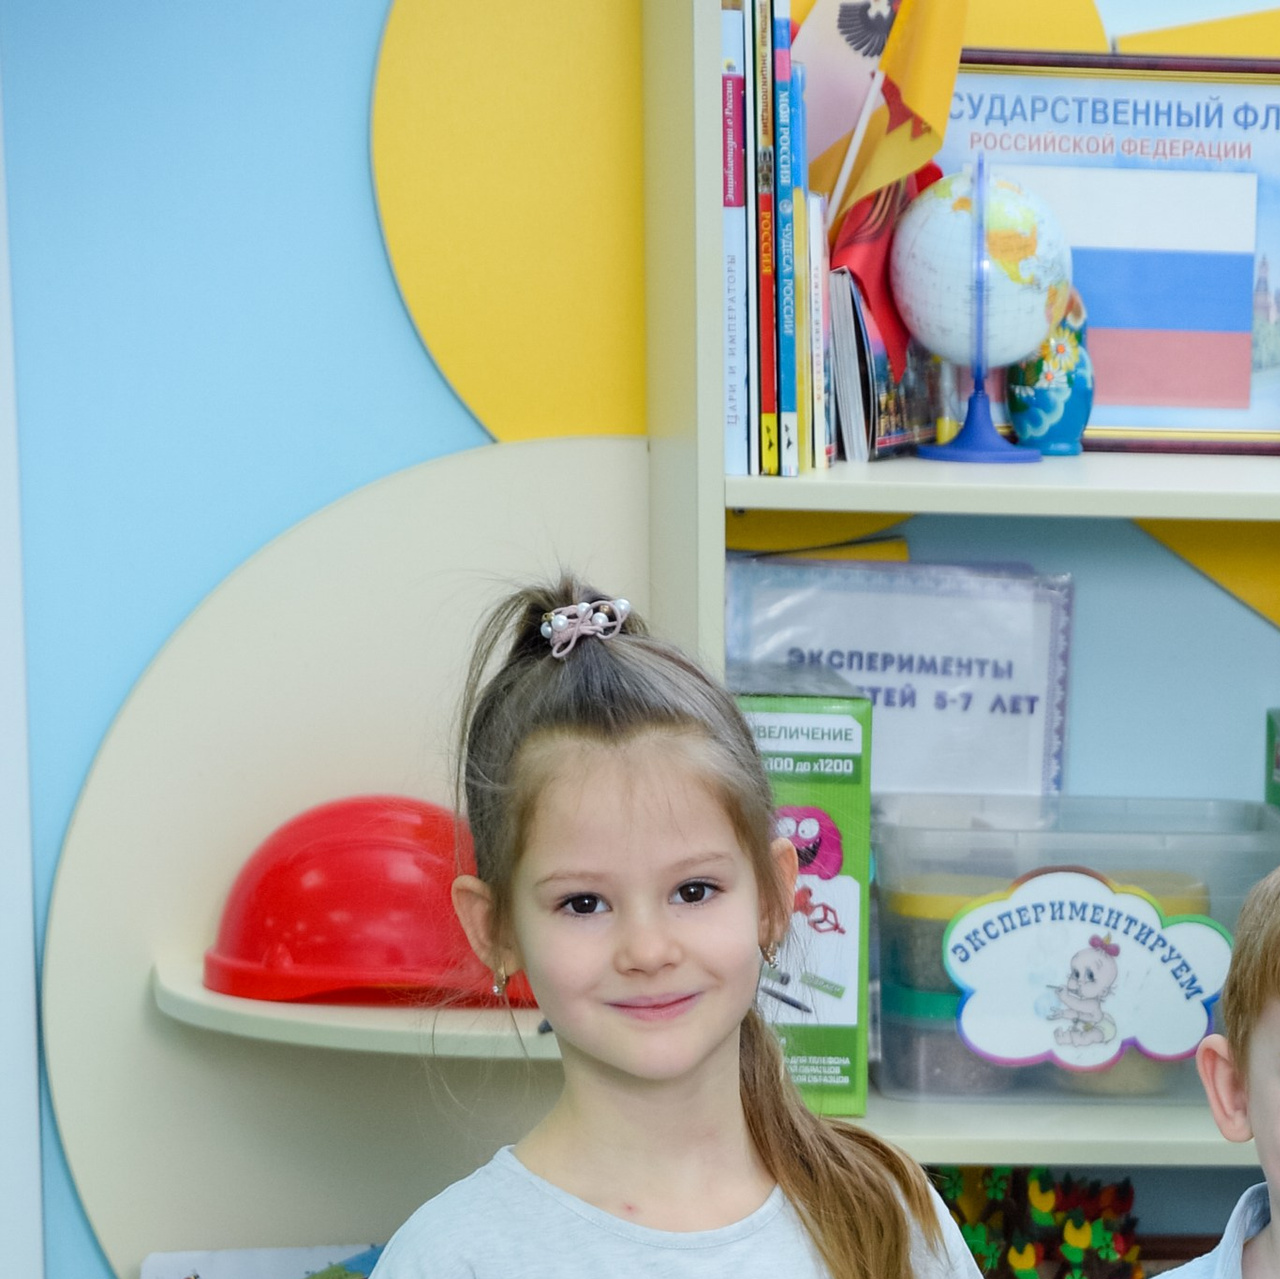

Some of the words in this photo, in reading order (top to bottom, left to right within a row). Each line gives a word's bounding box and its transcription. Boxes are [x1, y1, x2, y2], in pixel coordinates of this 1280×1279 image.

[778, 91, 791, 128] МОЯ
[948, 91, 1224, 129] СУДАРСТВЕННЫЙ
[779, 130, 792, 187] РОССИЯ
[969, 131, 1116, 155] РОССИЙСКОЙ
[1120, 135, 1252, 162] ФЕДЕРАЦИИ
[761, 211, 773, 276] РОССИЯ
[782, 222, 793, 275] ЧУДЕСА
[783, 278, 795, 336] РОССИИ
[786, 647, 1013, 680] ЭКСПЕРИМЕНТЫ
[988, 694, 1040, 715] ЛЕТ
[951, 899, 1205, 1001] ЭКСПЕРИМЕНТИРУЕМ
